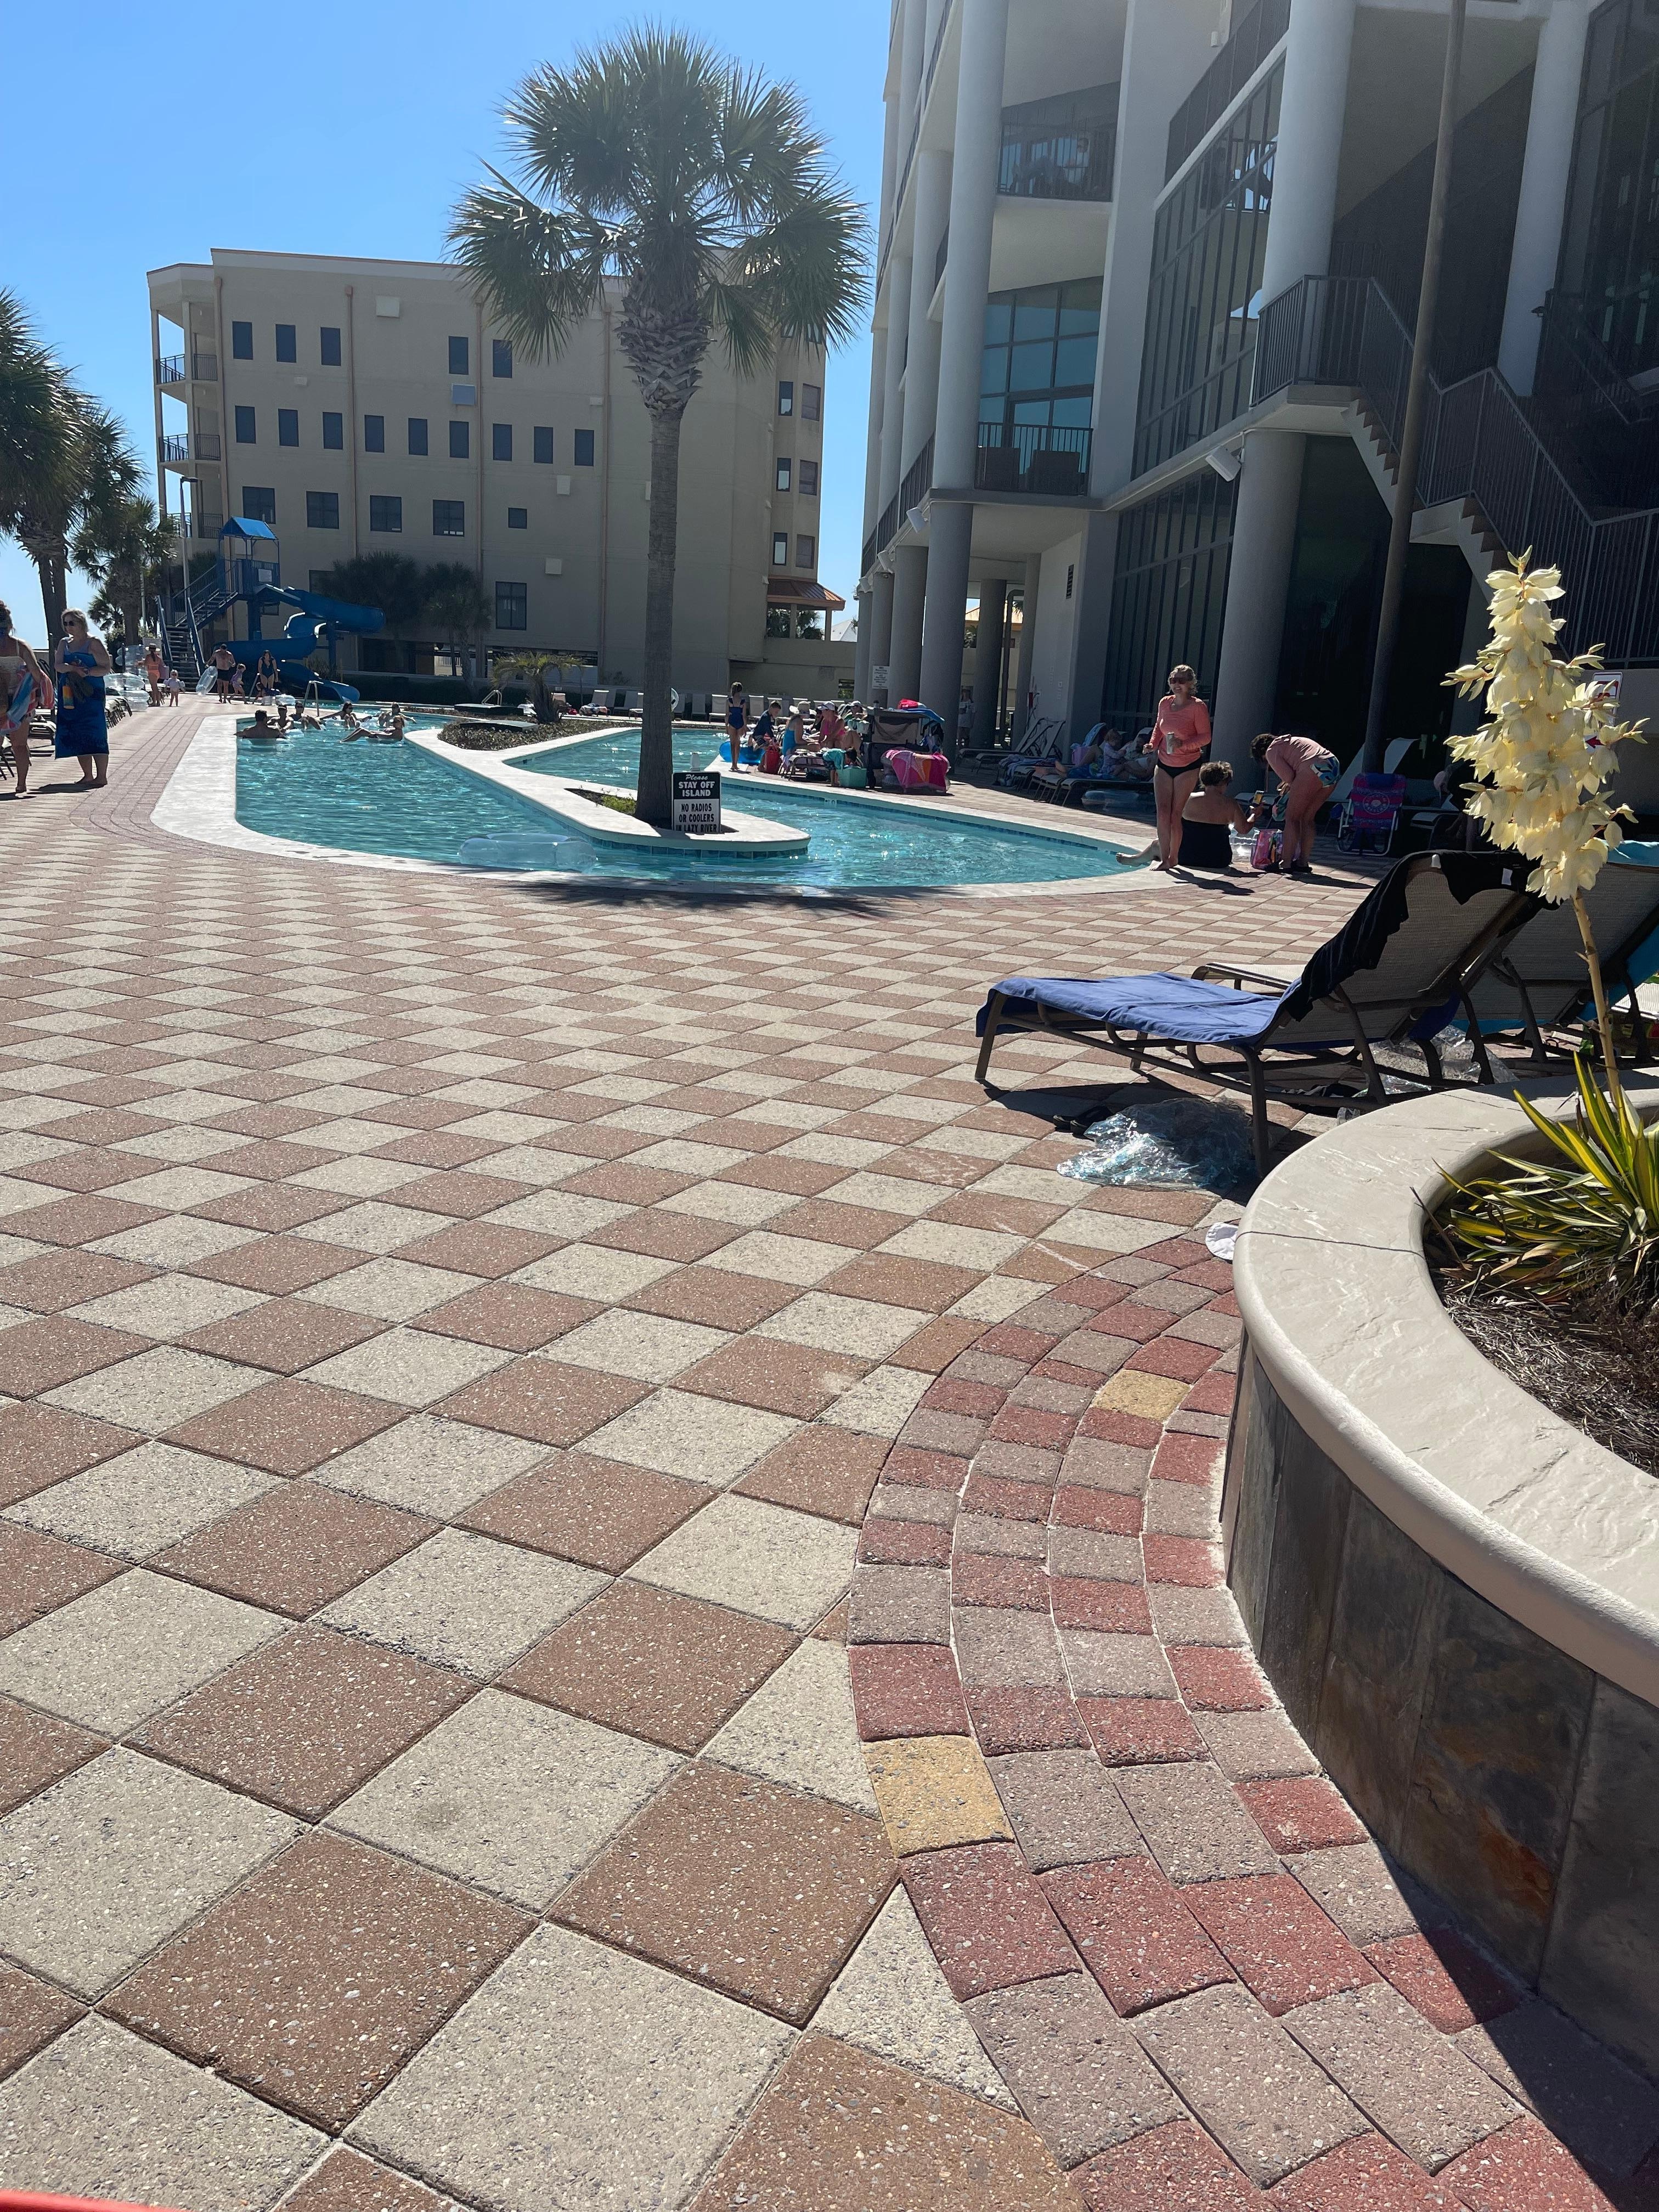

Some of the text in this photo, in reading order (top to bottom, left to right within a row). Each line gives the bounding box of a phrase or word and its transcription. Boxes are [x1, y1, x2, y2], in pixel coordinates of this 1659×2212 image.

[681, 803, 712, 812] NO RADIOS
[679, 814, 714, 822] OR COOLERS
[684, 824, 698, 832] LAZY
[701, 824, 717, 832] RIVER
